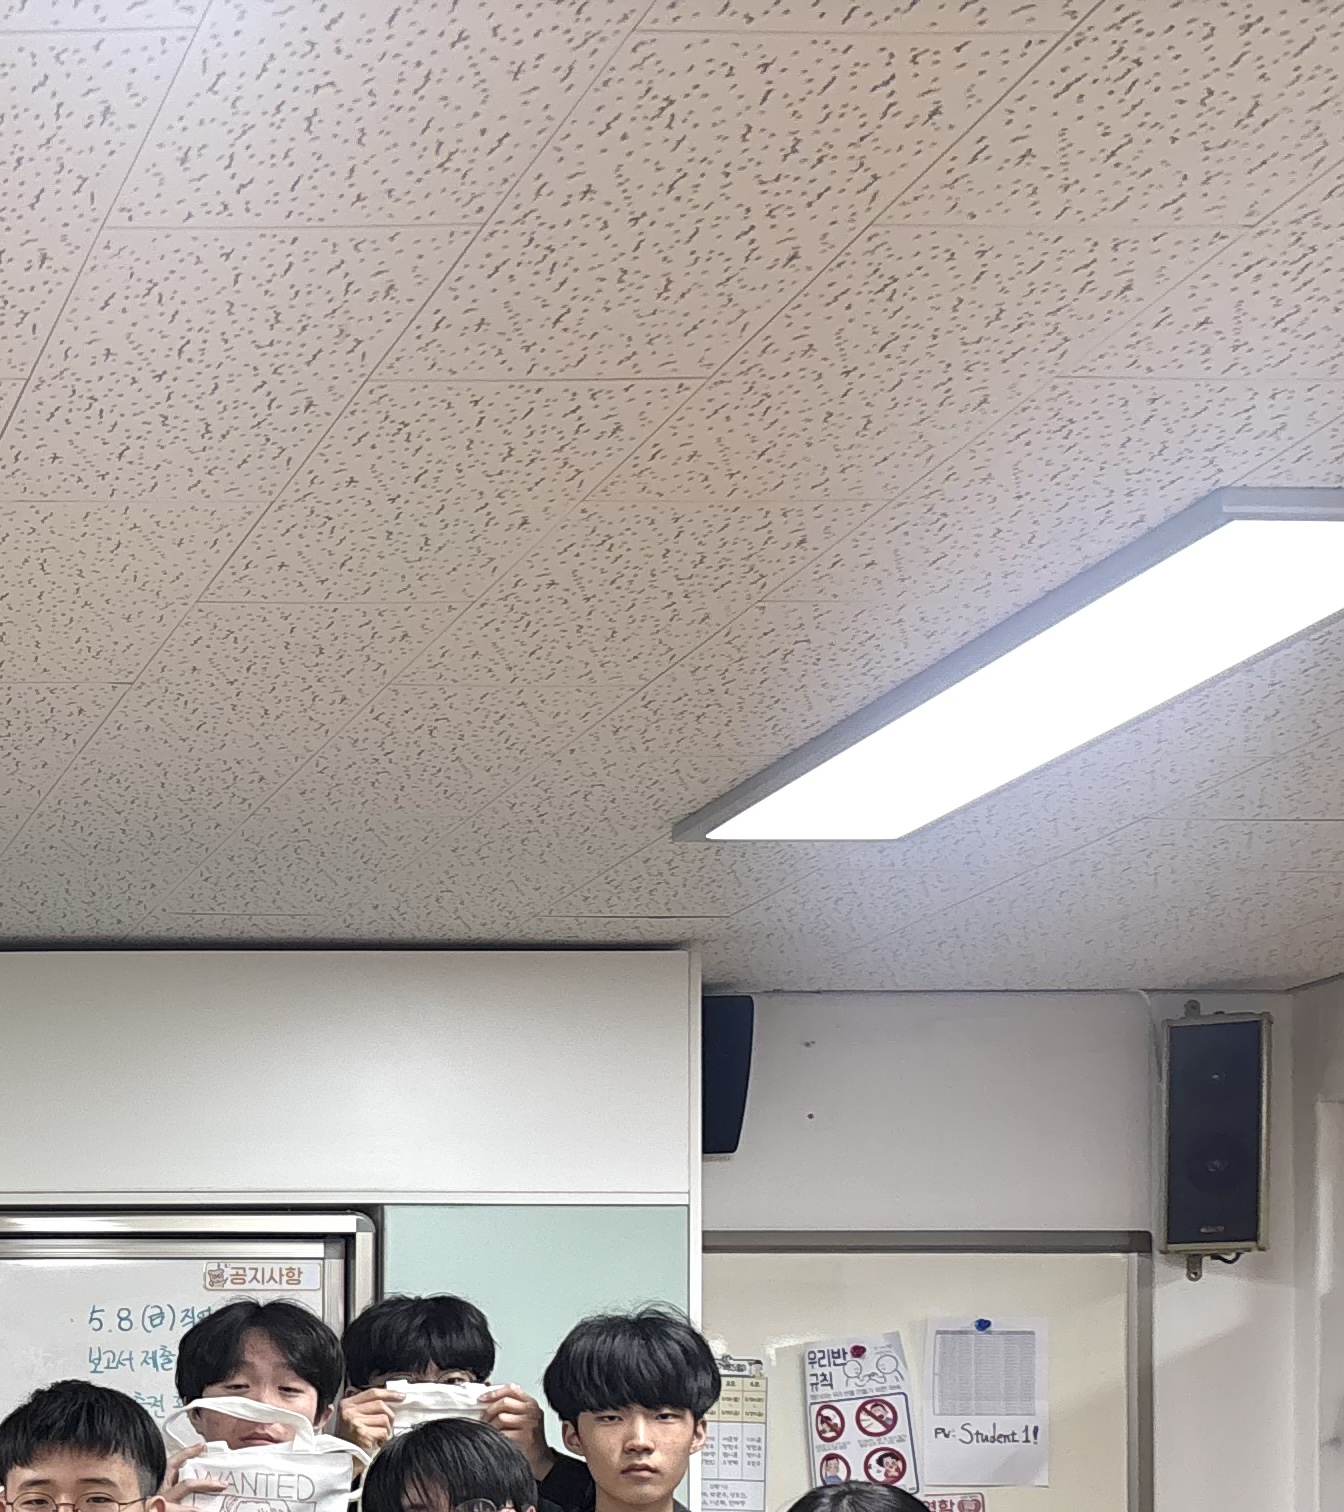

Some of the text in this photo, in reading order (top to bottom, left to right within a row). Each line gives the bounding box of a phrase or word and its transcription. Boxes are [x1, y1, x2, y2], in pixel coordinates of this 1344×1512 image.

[229, 1266, 303, 1286] 공지사항
[88, 1344, 176, 1374] 보고서 제출
[807, 1347, 848, 1370] 우리반
[809, 1371, 833, 1392] 규칙
[958, 1422, 1020, 1445] Student
